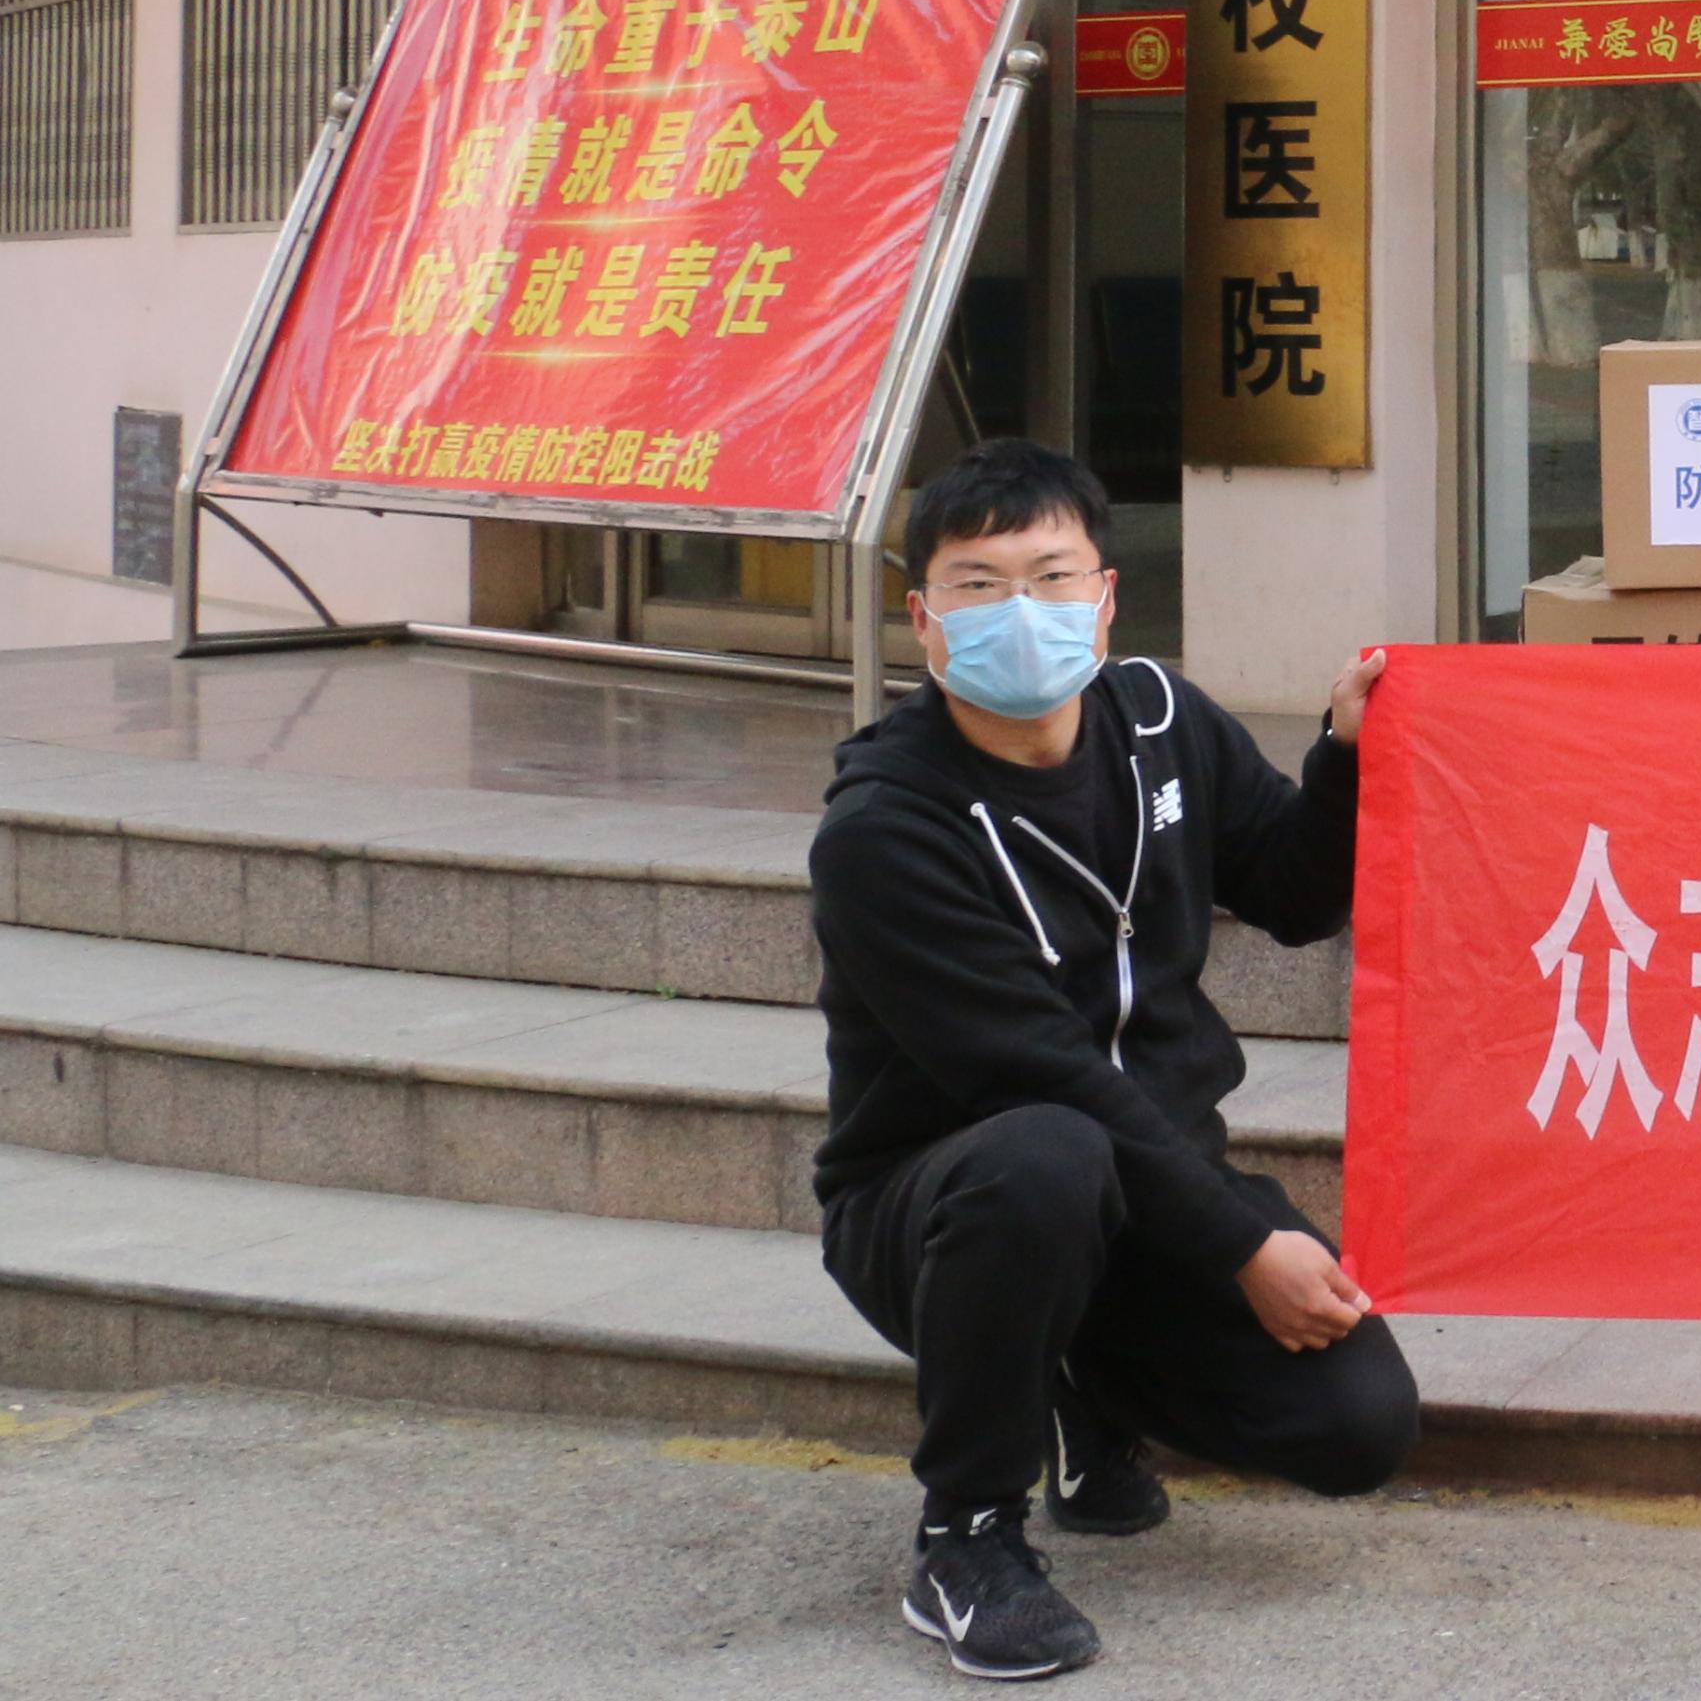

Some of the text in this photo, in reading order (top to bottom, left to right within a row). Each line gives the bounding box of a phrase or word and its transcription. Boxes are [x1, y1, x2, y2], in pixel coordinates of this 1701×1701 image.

[437, 99, 840, 211] 疫情就是命令
[393, 239, 794, 340] 防疫就是责任
[331, 418, 720, 493] 坚决打赢疫情防控阻击战
